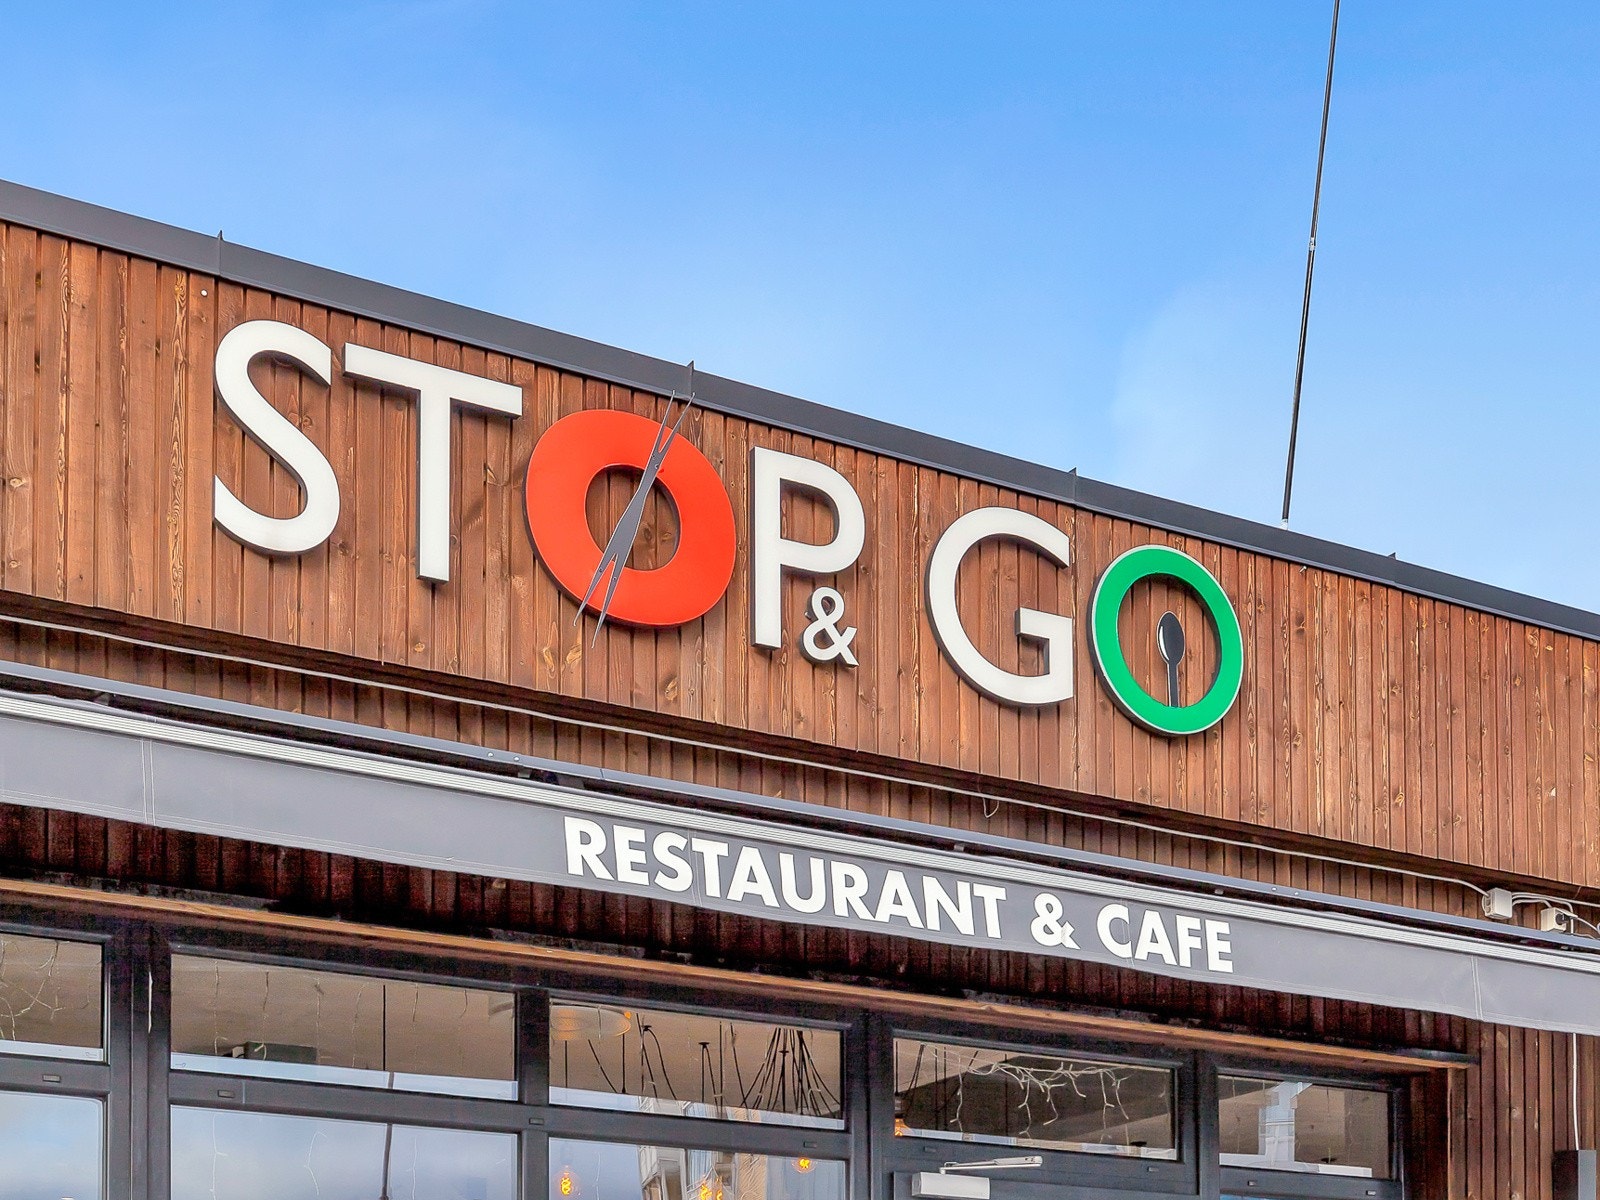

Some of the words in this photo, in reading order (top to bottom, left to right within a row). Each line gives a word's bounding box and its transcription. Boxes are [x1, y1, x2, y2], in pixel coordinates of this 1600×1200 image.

[213, 319, 866, 650] STOP
[801, 586, 859, 668] &
[925, 506, 1244, 736] GO
[563, 815, 1007, 939] RESTAURANT
[1030, 892, 1081, 950] &
[1096, 903, 1234, 973] CAFE
